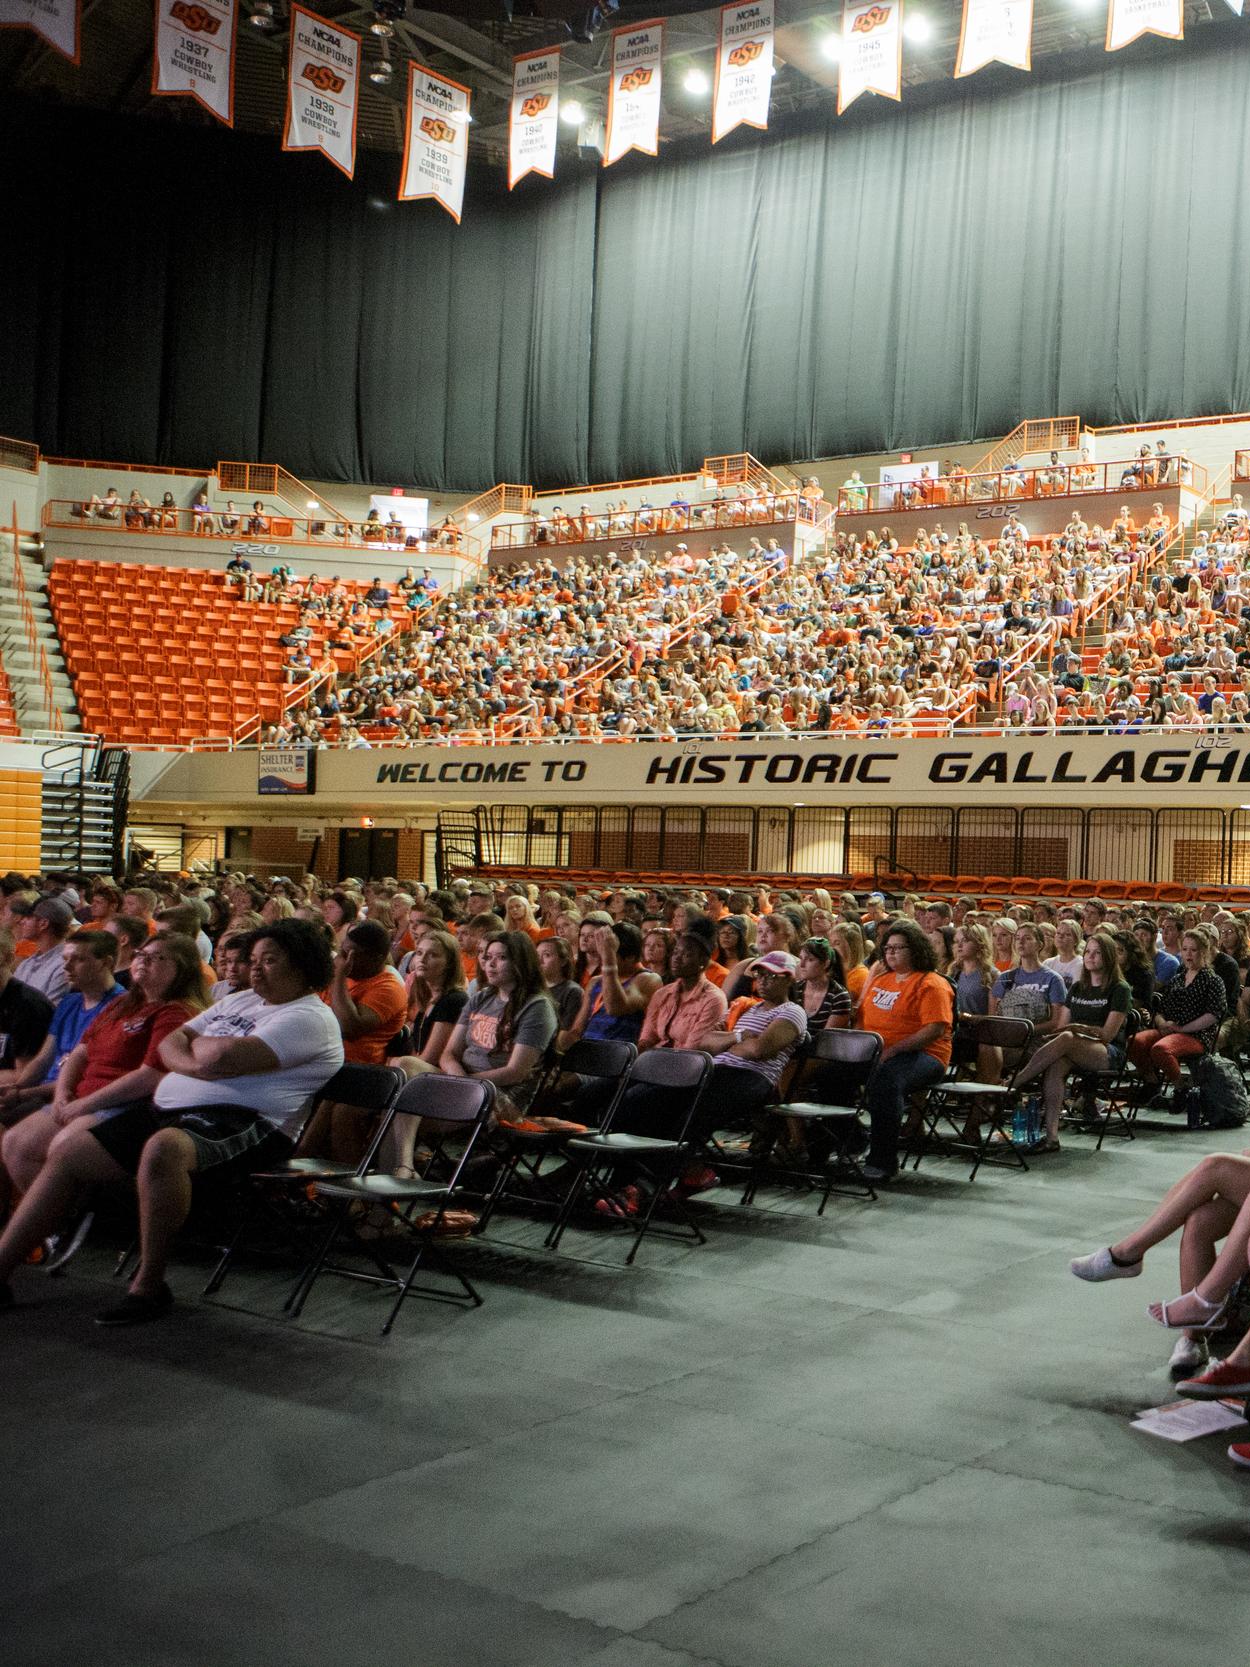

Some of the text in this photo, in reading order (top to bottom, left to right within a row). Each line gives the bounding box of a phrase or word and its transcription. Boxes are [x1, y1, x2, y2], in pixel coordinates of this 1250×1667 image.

[736, 7, 760, 21] NCAA
[725, 17, 771, 36] CHAMPIONS
[180, 37, 209, 57] 1937
[313, 27, 341, 48] NCAA
[627, 34, 650, 47] NCAA
[298, 32, 353, 67] CHAMPIONS
[616, 44, 659, 62] CHAMPIONS
[171, 57, 216, 83] WRESTLING
[174, 49, 213, 73] COWBOY
[526, 61, 548, 73] NCAA
[516, 71, 558, 88] CHAMPIONS
[415, 88, 462, 113] CHAMPIO
[427, 82, 453, 101] NCAA
[310, 96, 335, 116] 1938
[301, 115, 341, 138] WRESTLING
[304, 108, 338, 128] COWBOY
[426, 147, 448, 164] 1939
[418, 165, 453, 186] WRESTLING
[421, 158, 451, 177] COWBOY
[232, 542, 280, 555] 220
[1195, 734, 1234, 748] 102
[261, 754, 293, 765] SHELTER
[376, 761, 531, 783] WELCOME
[541, 760, 587, 782] TO
[646, 752, 899, 783] HISTORIC
